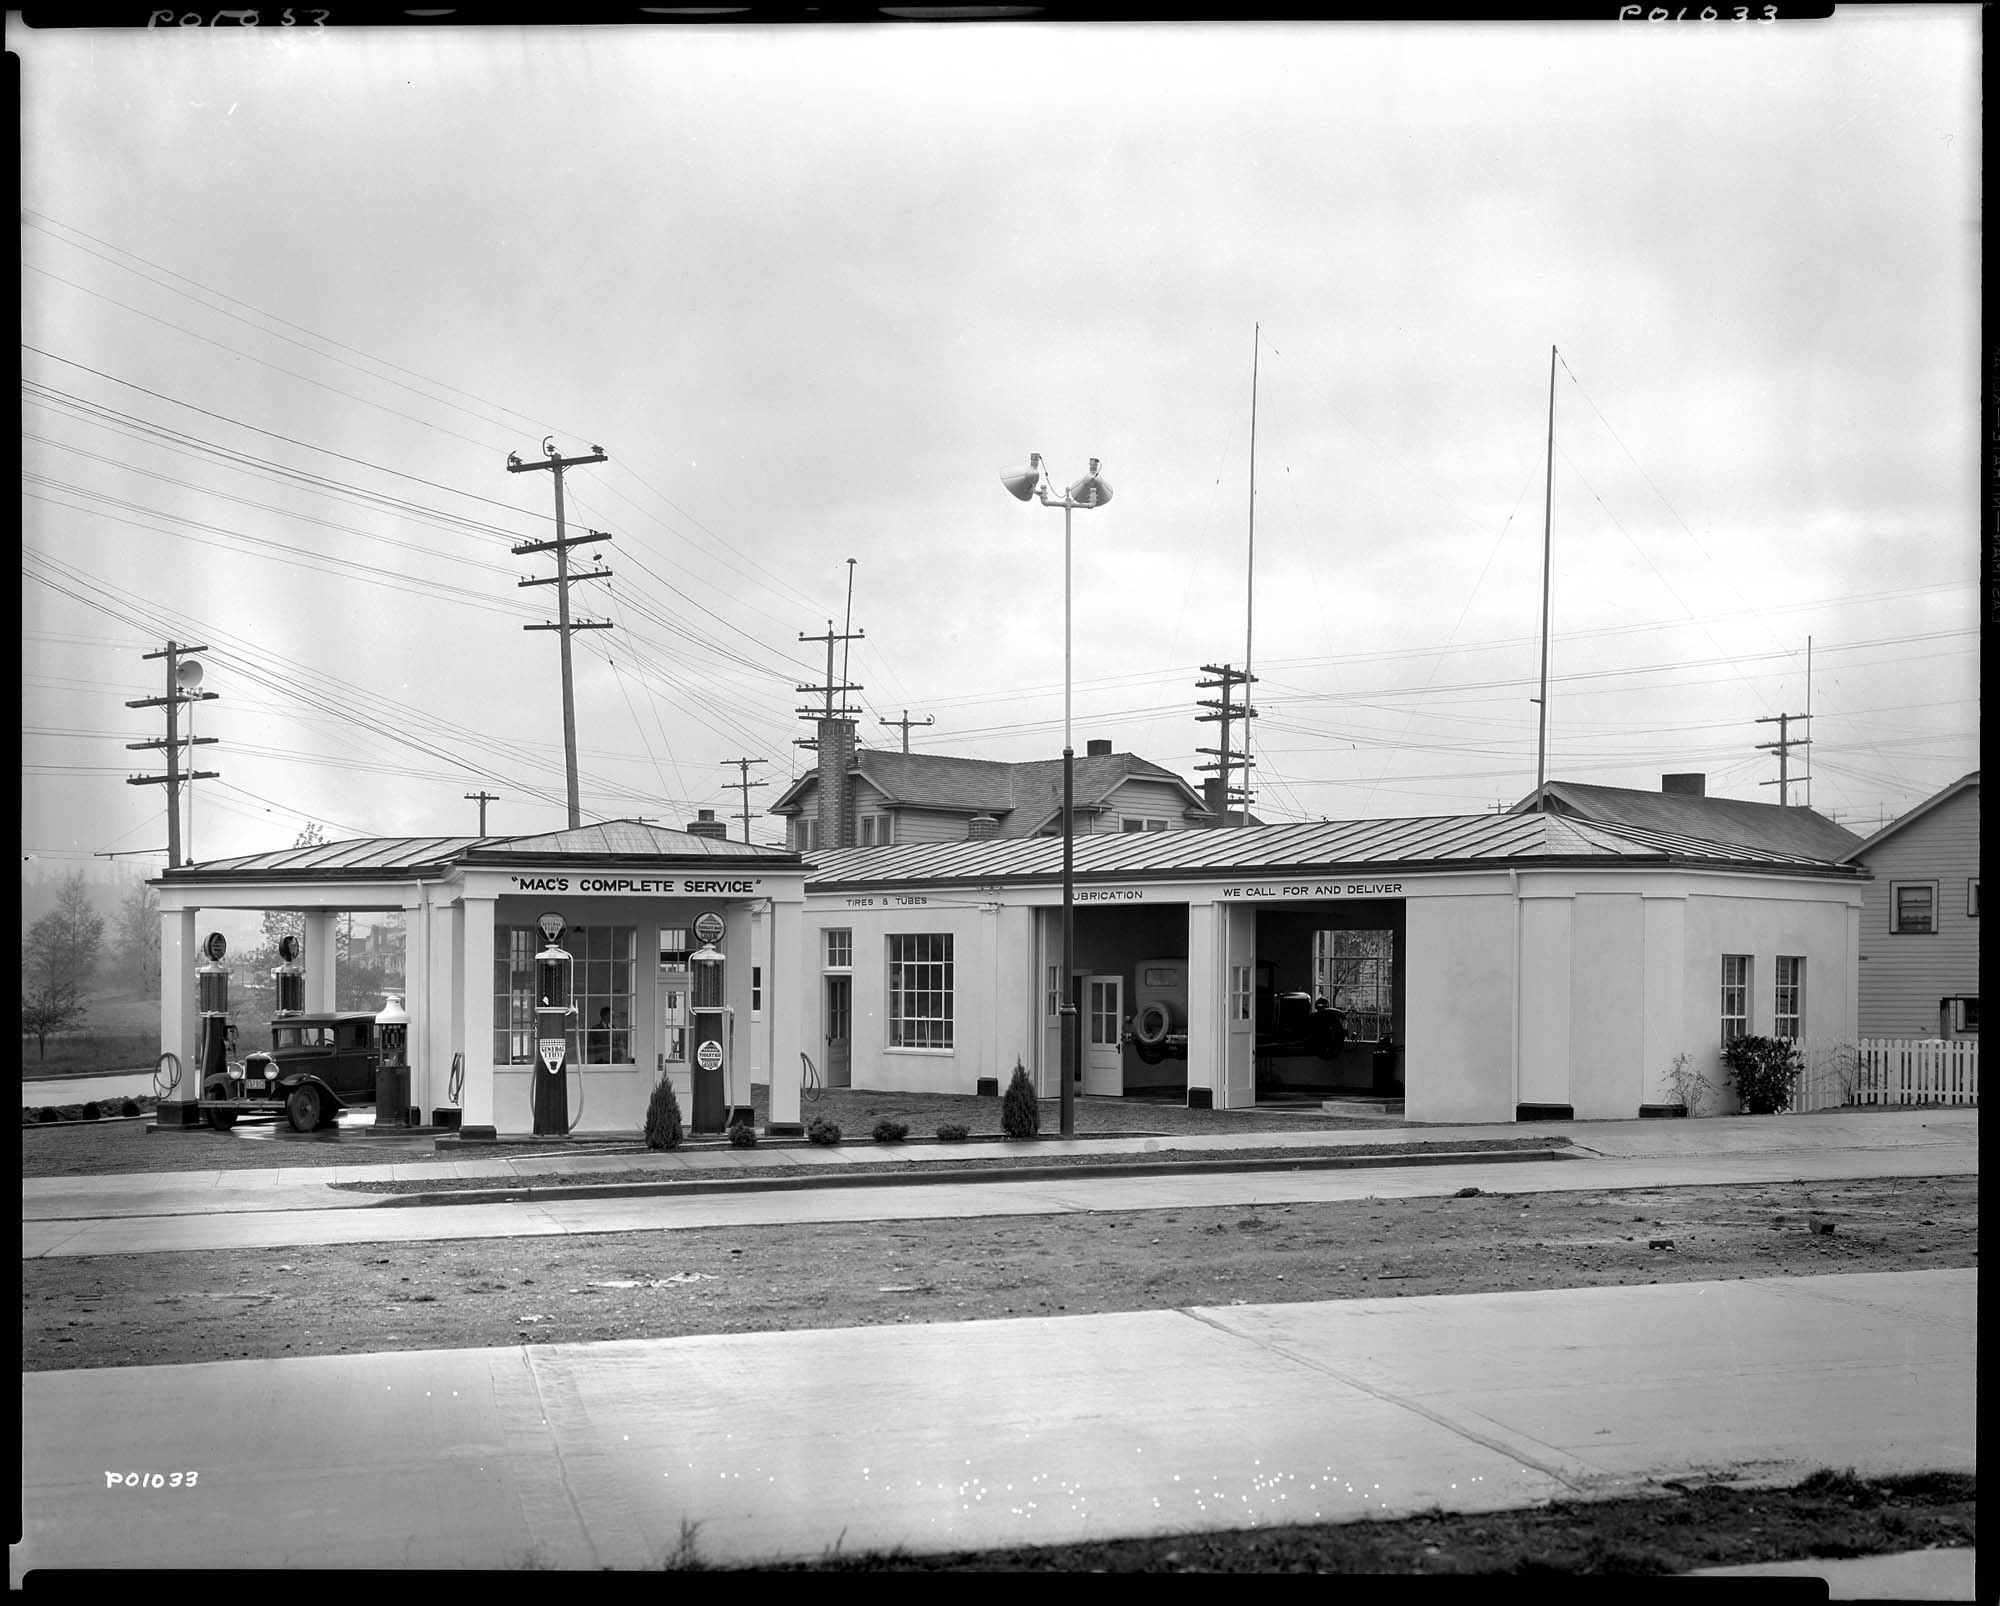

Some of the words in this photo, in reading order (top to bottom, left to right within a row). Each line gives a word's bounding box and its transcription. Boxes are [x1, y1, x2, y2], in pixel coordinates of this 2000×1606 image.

[580, 879, 674, 892] COMPLETE
[1223, 888, 1240, 897] WE
[1246, 888, 1276, 897] CALL
[1283, 886, 1309, 896] FOR
[1315, 886, 1342, 896] AND
[1347, 884, 1402, 895] DELIVER
[1072, 890, 1143, 901] UBRICATION
[846, 898, 874, 907] TIRES
[882, 898, 889, 906] &
[895, 897, 928, 906] TUBES
